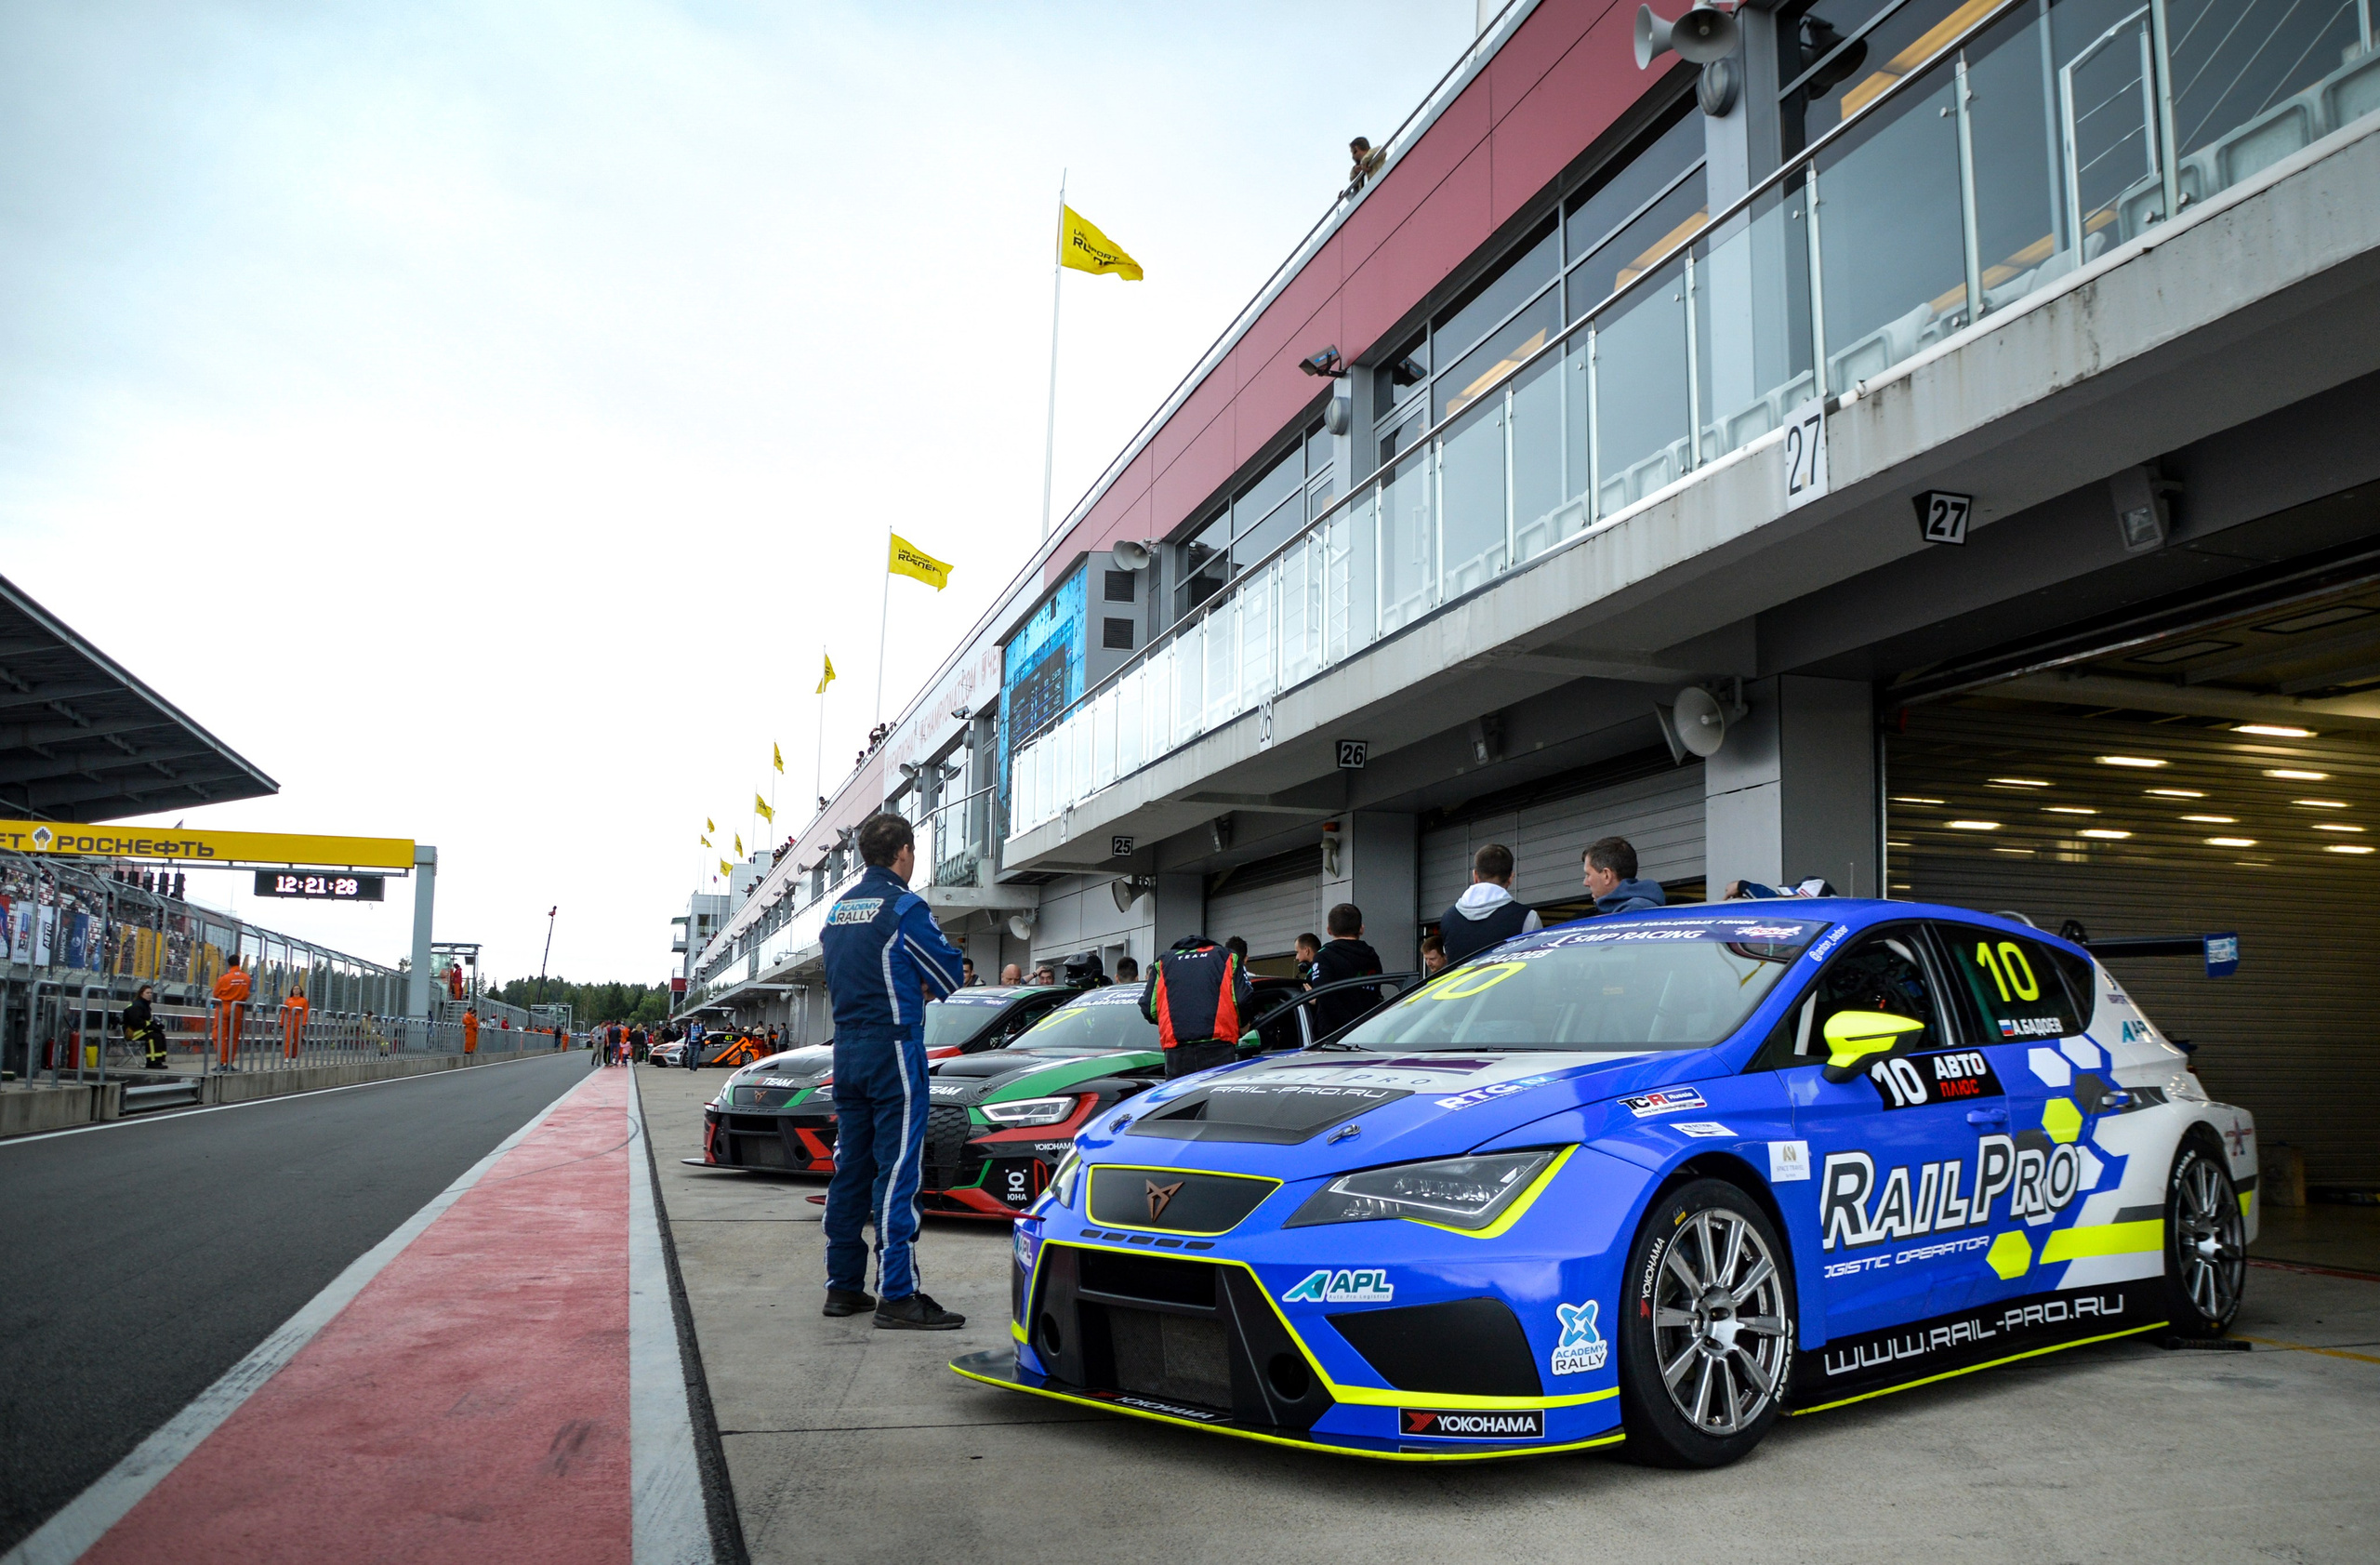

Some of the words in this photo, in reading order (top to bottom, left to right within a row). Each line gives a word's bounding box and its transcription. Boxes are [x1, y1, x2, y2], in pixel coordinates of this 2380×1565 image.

[1787, 413, 1821, 497] 27
[1928, 499, 1967, 537] 27
[1259, 700, 1273, 743] 26
[1341, 744, 1365, 765] 26
[56, 835, 215, 857] РОСНЕФТЬ
[1114, 839, 1131, 855] 25
[275, 876, 358, 895] 12:21:28
[836, 910, 878, 922] RALLY
[840, 902, 880, 911] ACADEMY
[1567, 933, 1618, 944] SMP
[1616, 930, 1707, 940] RACING
[1178, 952, 1208, 961] TEAM
[1976, 941, 2040, 1002] 10
[1401, 962, 1527, 1006] 10
[2012, 1017, 2064, 1036] А.БАДОЕВ
[1933, 1052, 1987, 1081] АВТО
[761, 1077, 795, 1088] TEAM
[1210, 1085, 1389, 1099] RAIL-PRO.RU
[1871, 1057, 1928, 1107] 10
[1939, 1079, 1980, 1098] ПЛЮС
[1433, 1083, 1524, 1110] RTG
[1618, 1094, 1670, 1110] TCR
[1667, 1092, 1694, 1100] Russia
[1007, 1193, 1027, 1201] ЮНА
[1895, 1235, 1990, 1265] OPERATOR
[1642, 1238, 1665, 1299] YOKOHAMA
[1329, 1272, 1390, 1293] APL
[1823, 1293, 2125, 1376] WWW.RAIL-PRO.RU
[1555, 1344, 1606, 1359] ACADEMY
[1555, 1352, 1606, 1372] RALLY
[1774, 1318, 1795, 1403] ADVAN
[1114, 1396, 1216, 1420] YOKOHAMA
[1437, 1415, 1538, 1434] YOKOHAMA
